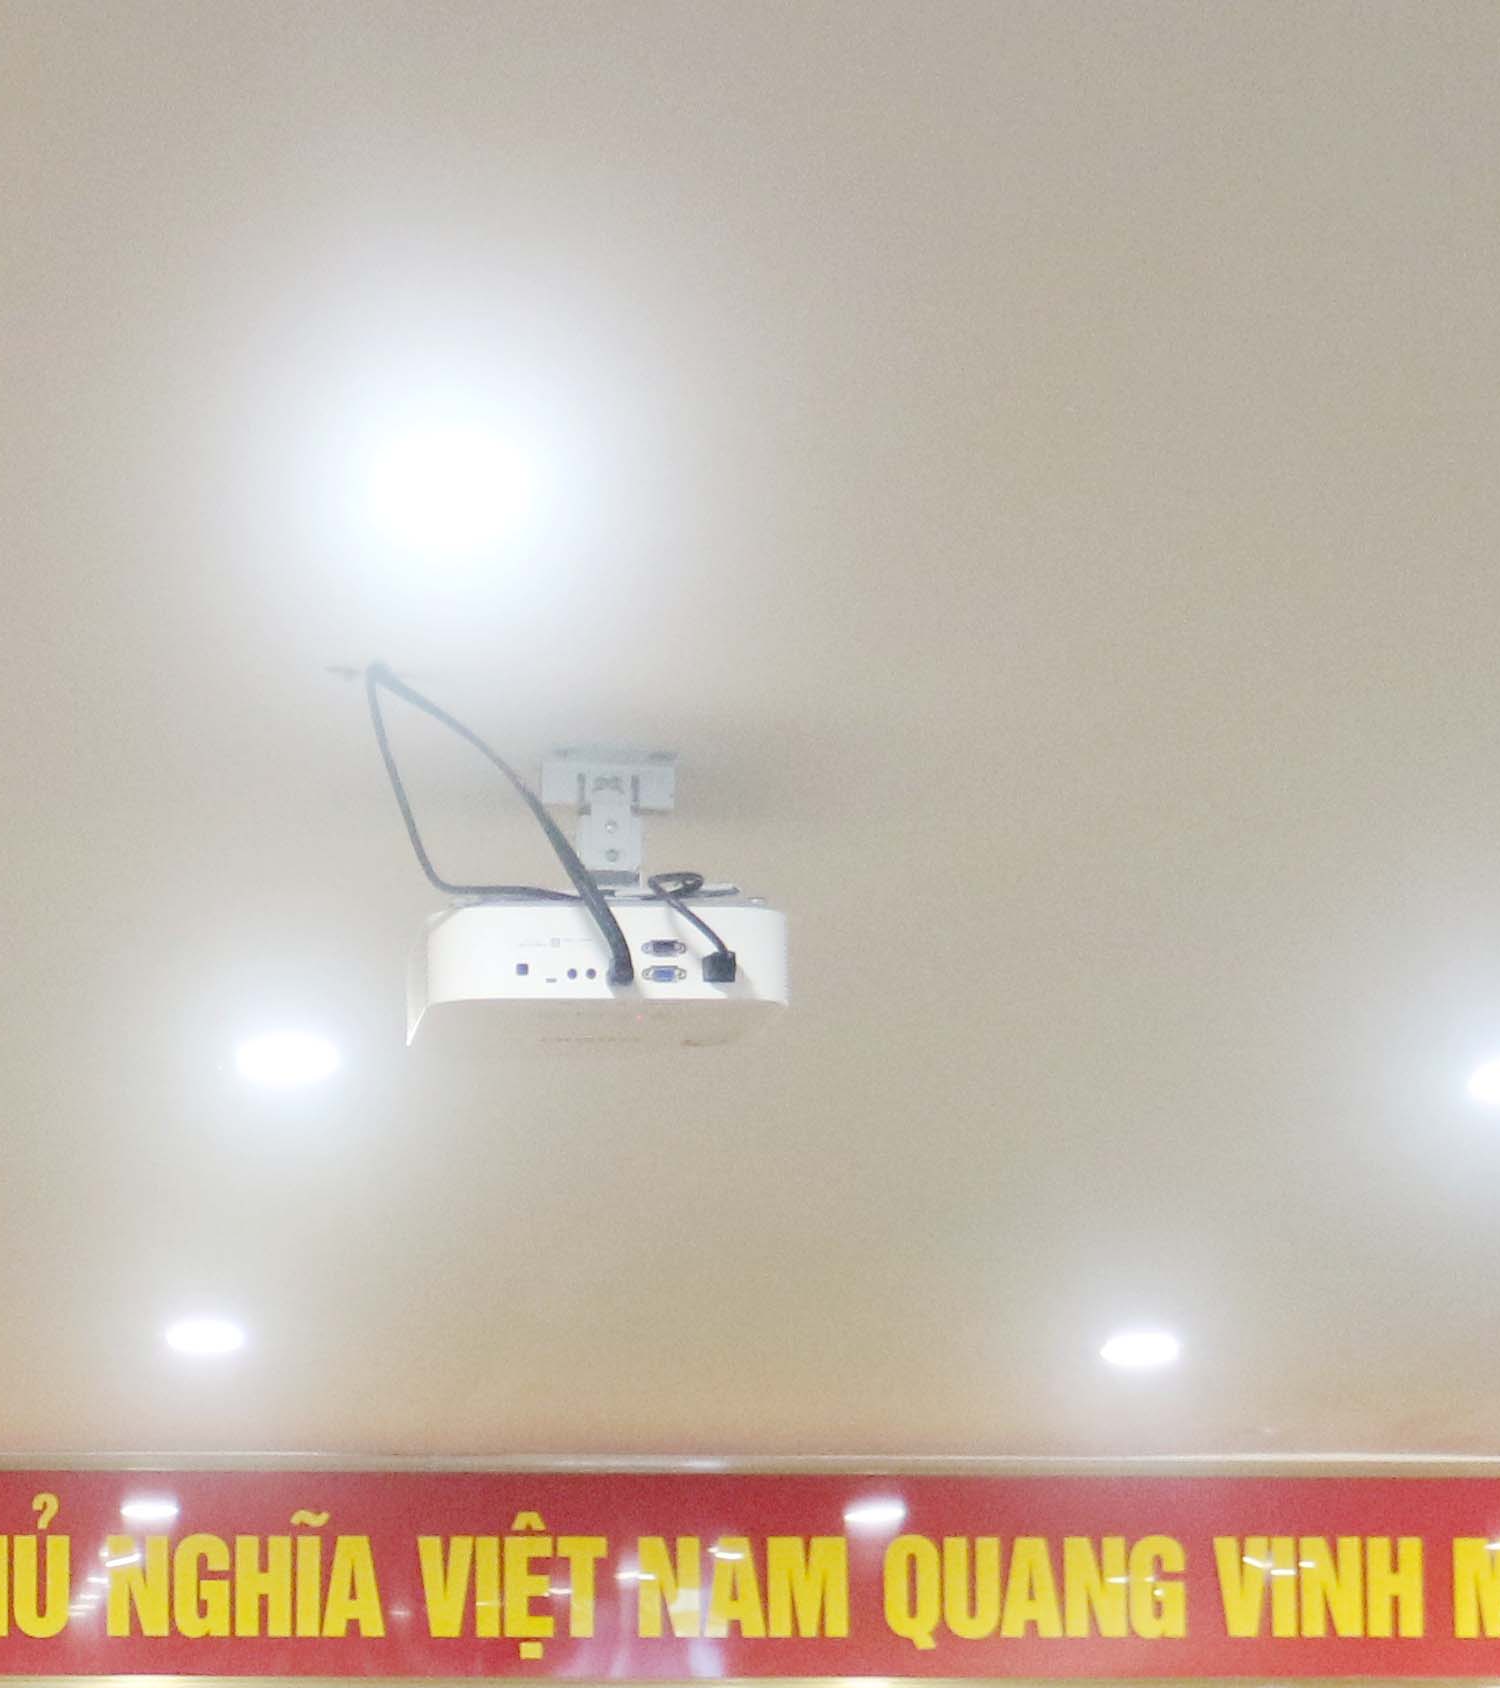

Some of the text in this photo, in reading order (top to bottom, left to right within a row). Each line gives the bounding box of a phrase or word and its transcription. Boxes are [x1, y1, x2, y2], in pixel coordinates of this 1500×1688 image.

[108, 1512, 386, 1638] NGHĨA
[419, 1512, 607, 1659] VIỆT
[637, 1535, 850, 1637] NAM
[884, 1535, 1186, 1648] QUANG
[1215, 1536, 1425, 1638] VINH
